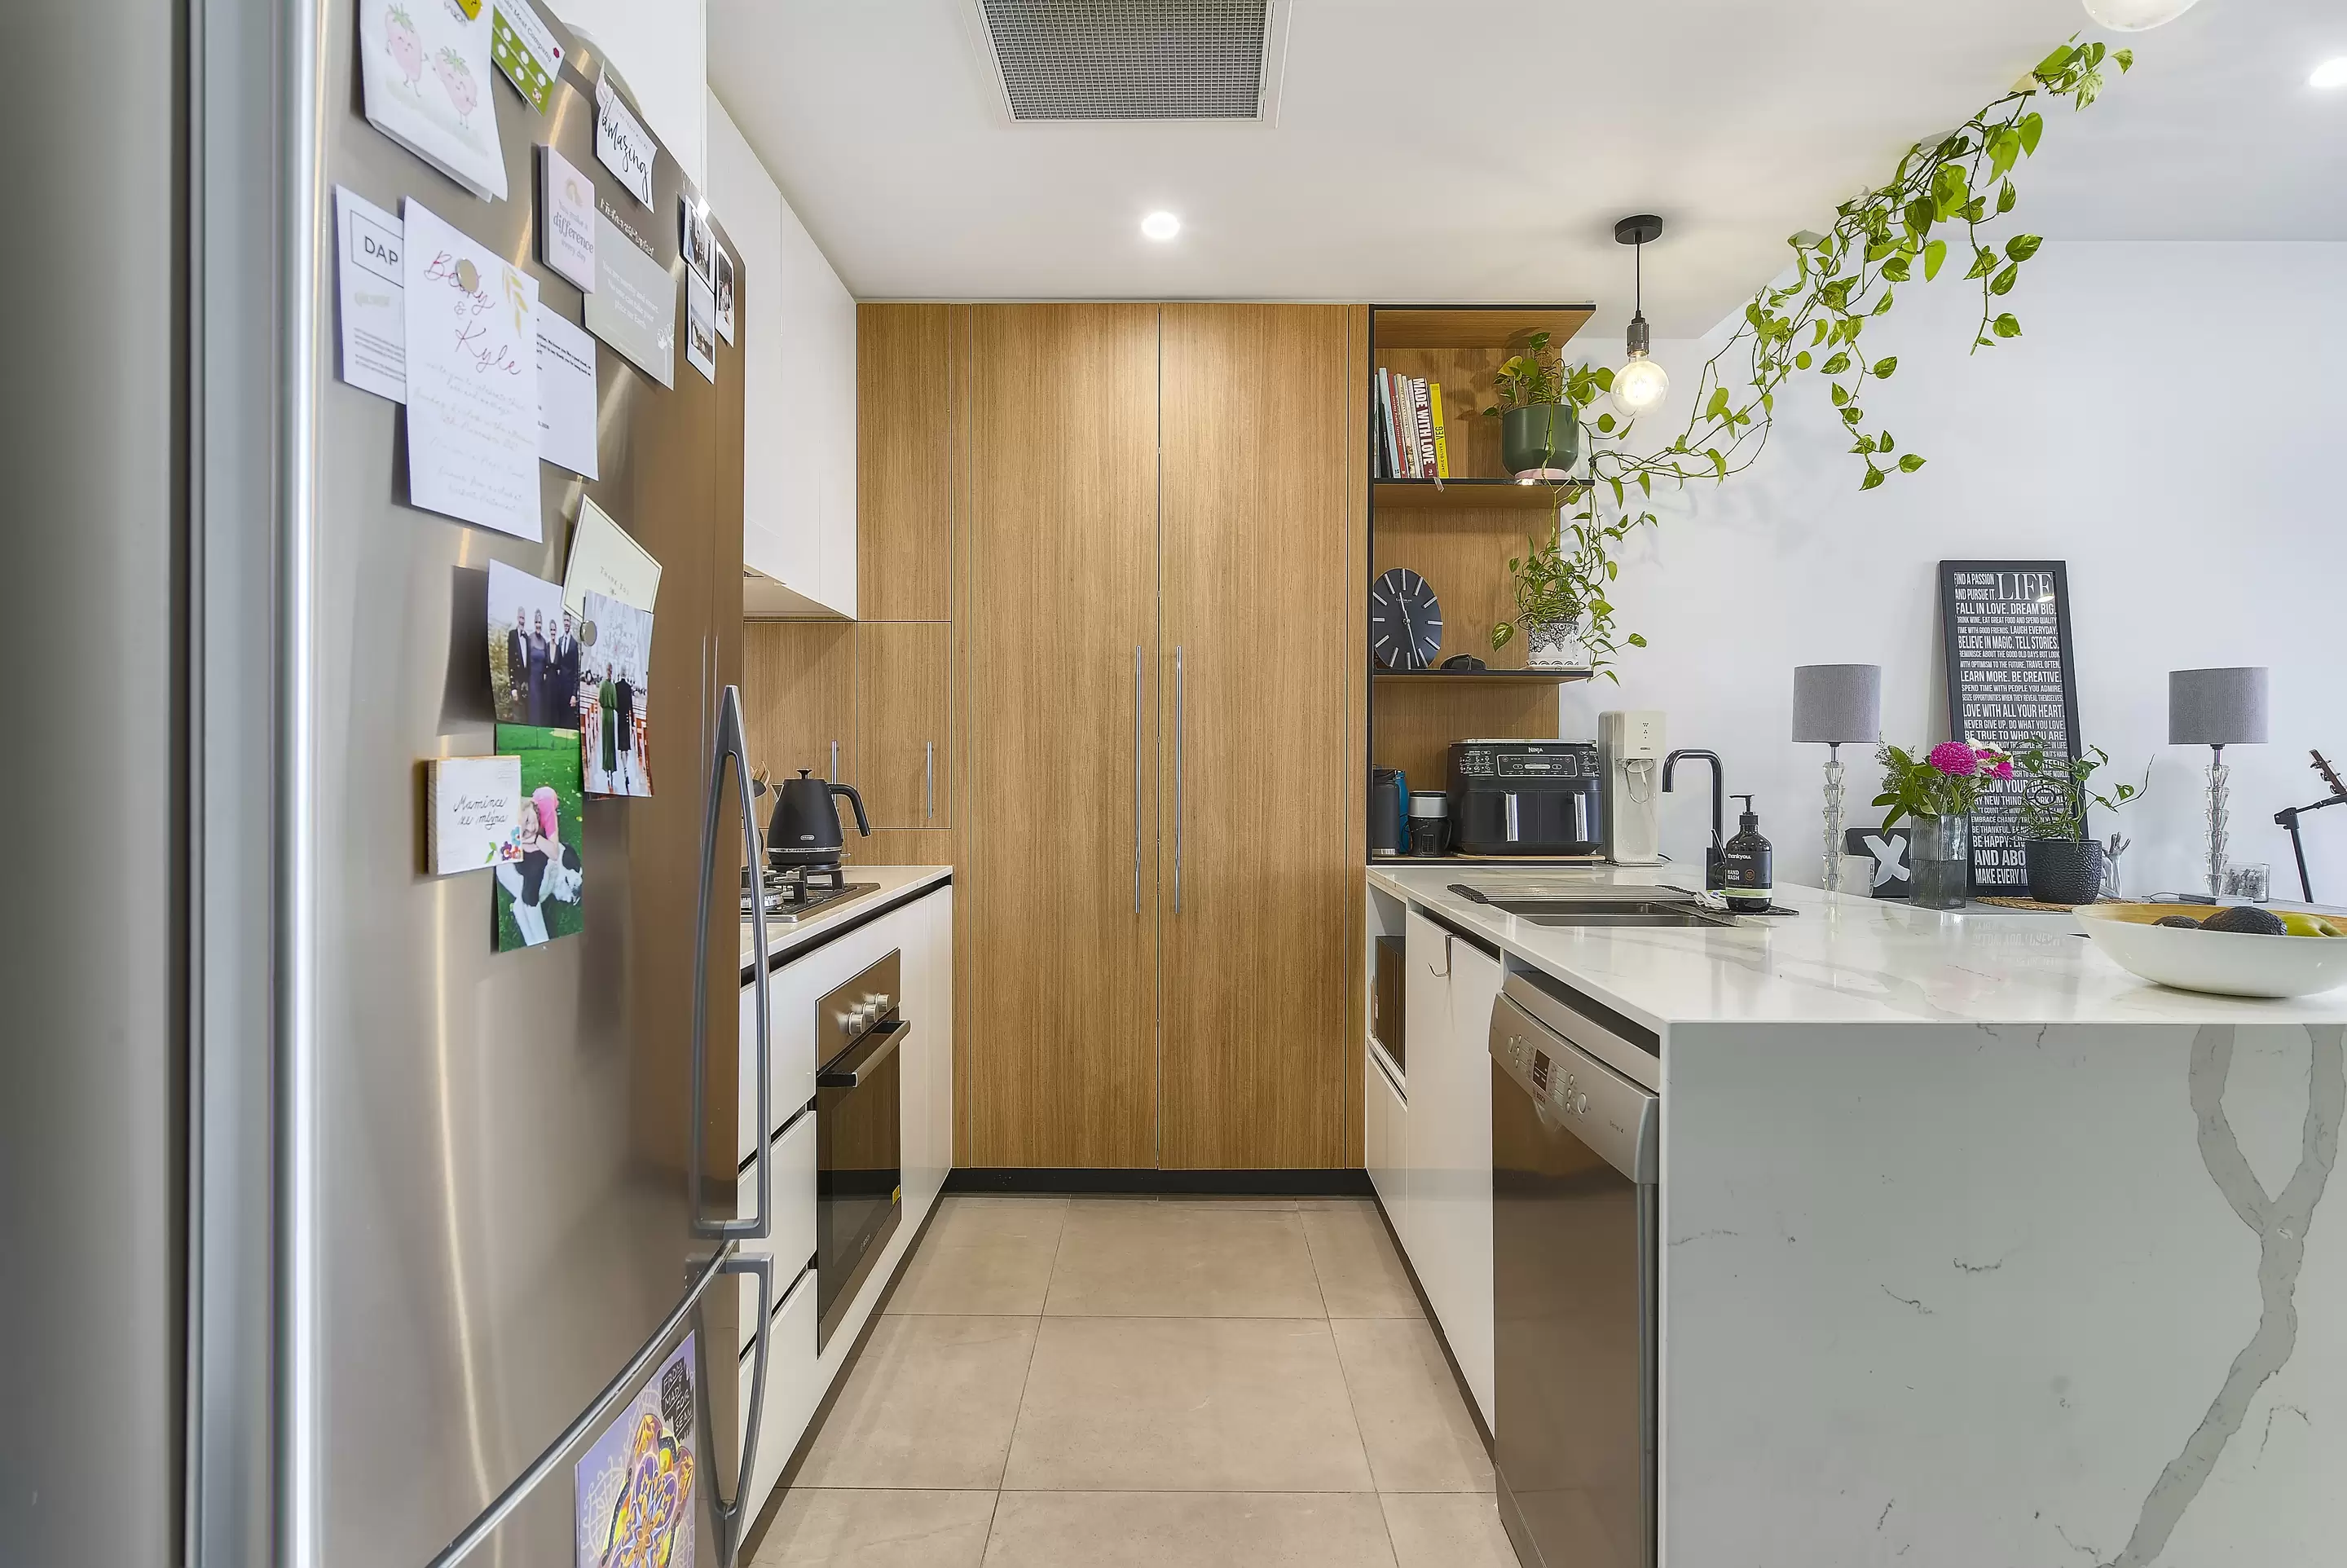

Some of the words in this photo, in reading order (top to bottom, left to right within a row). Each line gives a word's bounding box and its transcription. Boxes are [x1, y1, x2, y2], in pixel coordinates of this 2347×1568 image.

[527, 28, 553, 63] Company
[553, 212, 594, 253] difference
[364, 235, 399, 266] DAP
[455, 319, 522, 375] Kyle
[1413, 377, 1428, 408] MADE
[1416, 408, 1432, 438] WITH
[1435, 425, 1444, 441] VEG
[1420, 438, 1436, 465] LOVE
[1954, 573, 1966, 584] FIND
[1966, 573, 1971, 584] A
[1972, 573, 1994, 584] PASSION
[1955, 588, 1966, 601] AND
[1967, 588, 1988, 601] PURSUE
[1996, 573, 2052, 601] LIFE
[1956, 602, 1975, 614] FALL
[1976, 602, 1986, 614] IN
[1987, 602, 2009, 614] LOVE.
[2010, 602, 2039, 614] DREAM
[2041, 602, 2057, 614] BIG.
[1967, 626, 1979, 634] WITH
[1979, 626, 1990, 634] GOOD
[2010, 626, 2028, 634] LAUGH
[2028, 626, 2058, 634] EVERYDAY.
[1957, 636, 1984, 649] BELIEVE
[1984, 636, 1991, 649] IN
[1993, 636, 2015, 649] MAGIC.
[2015, 636, 2031, 649] TELL
[2031, 636, 2059, 649] STORIES.
[1999, 660, 2007, 668] THE
[2026, 660, 2044, 668] TRAVEL
[2044, 660, 2061, 668] OFTEN.
[1961, 671, 1984, 682] LEARN
[1986, 671, 2010, 682] MORE.
[2011, 671, 2023, 682] BE
[2023, 671, 2062, 682] CREATIVE.
[1962, 704, 1980, 717] LOVE
[1982, 704, 2001, 717] WITH
[2003, 704, 2016, 717] ALL
[2017, 704, 2037, 717] YOUR
[2038, 704, 2065, 717] HEART.
[1964, 720, 1983, 729] NEVER
[1984, 720, 1997, 729] GIVE
[1998, 720, 2008, 729] UP.
[2009, 720, 2017, 729] DO
[2017, 720, 2035, 729] WHAT
[2036, 720, 2048, 729] YOU
[2049, 720, 2066, 729] LOVE.
[1965, 730, 1975, 740] BE
[1976, 730, 1997, 740] TRUE
[1998, 730, 2009, 740] TO
[2010, 730, 2029, 740] WHO
[2048, 730, 2067, 740] ARE.
[1984, 795, 2000, 805] NEW
[2001, 795, 2023, 805] THING
[1973, 836, 1982, 847] BE
[1984, 836, 2012, 847] HAPPY.
[1975, 850, 1999, 865] AND
[2001, 850, 2026, 865] ABO
[1975, 869, 1996, 884] MAKE
[1997, 869, 2019, 884] EVERY
[663, 1362, 683, 1394] FROM
[676, 1389, 689, 1416] FOR
[676, 1409, 692, 1432] SEAN
